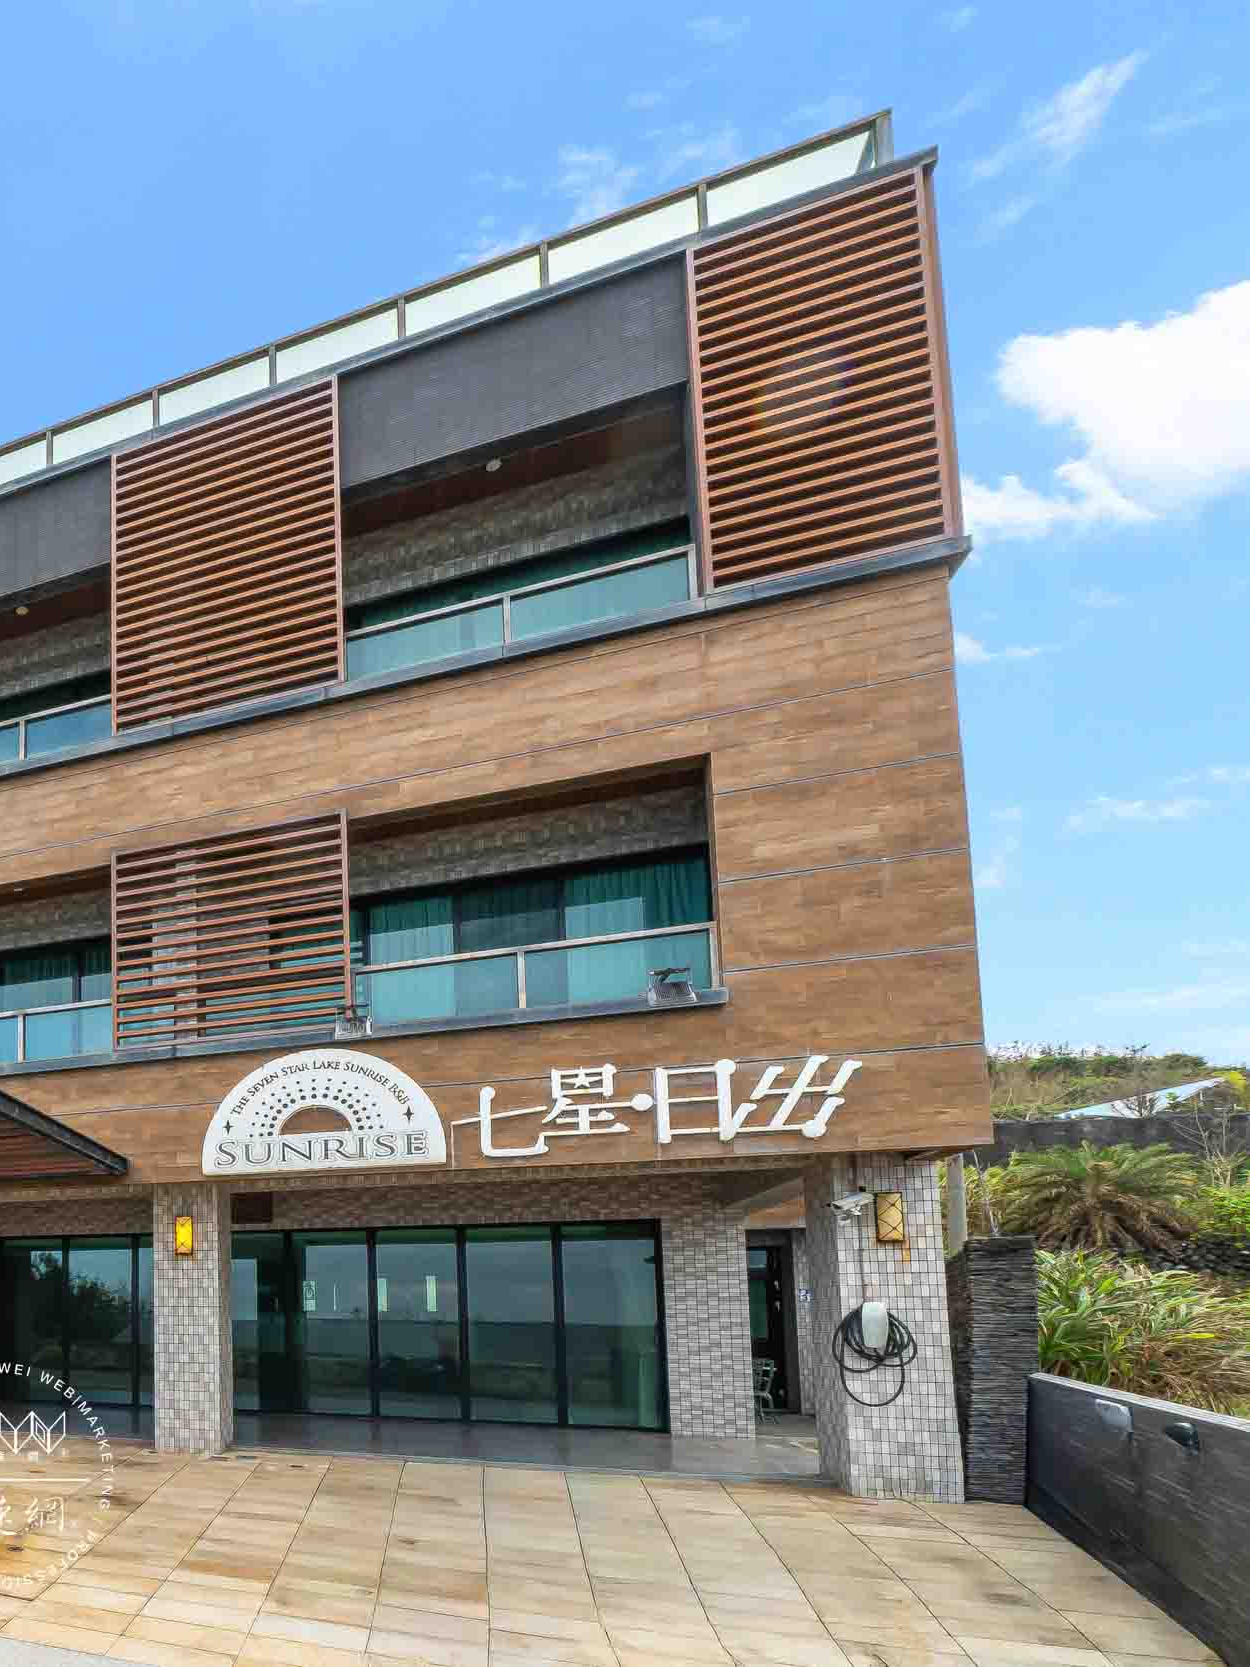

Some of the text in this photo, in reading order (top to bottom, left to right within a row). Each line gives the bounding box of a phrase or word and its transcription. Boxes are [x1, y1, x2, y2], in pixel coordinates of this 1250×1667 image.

[230, 1095, 250, 1116] THE
[247, 1071, 279, 1097] SEVEN
[280, 1062, 311, 1077] STAR
[312, 1060, 341, 1070] LAKE
[342, 1061, 391, 1088] SUNRISE
[214, 1130, 430, 1168] SUNRISE
